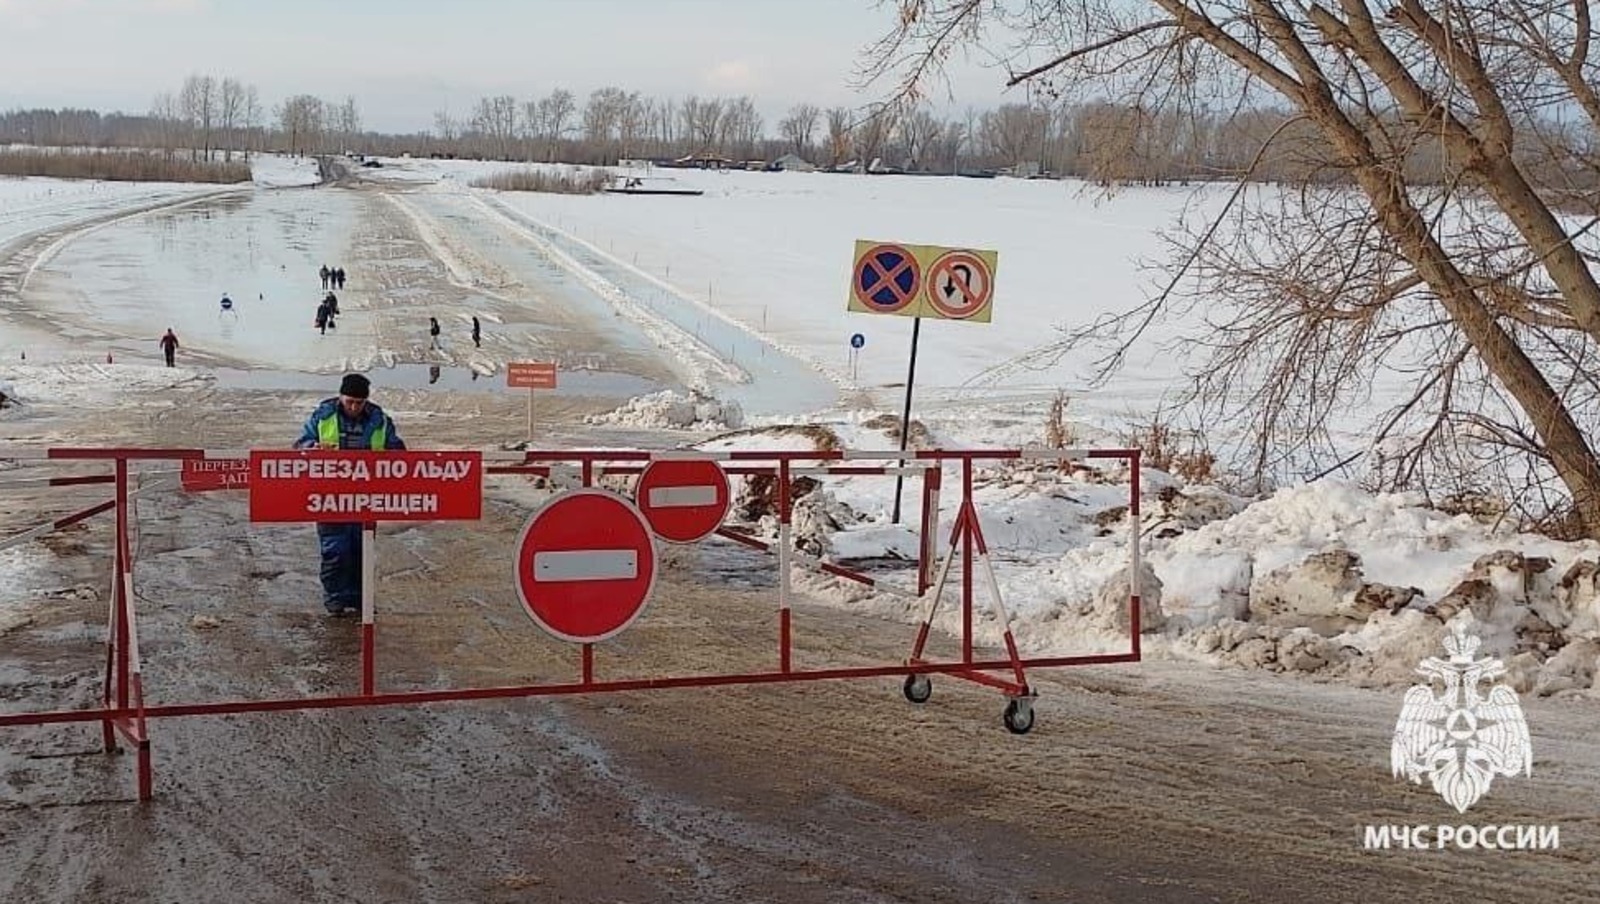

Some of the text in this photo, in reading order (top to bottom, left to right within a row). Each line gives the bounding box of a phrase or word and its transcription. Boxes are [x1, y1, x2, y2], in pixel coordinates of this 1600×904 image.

[218, 473, 250, 485] ЗАП
[261, 460, 472, 481] ПЕРЕЕЗД ПО ЛЬДУ
[307, 493, 438, 515] ЗАПРЕЩЕН
